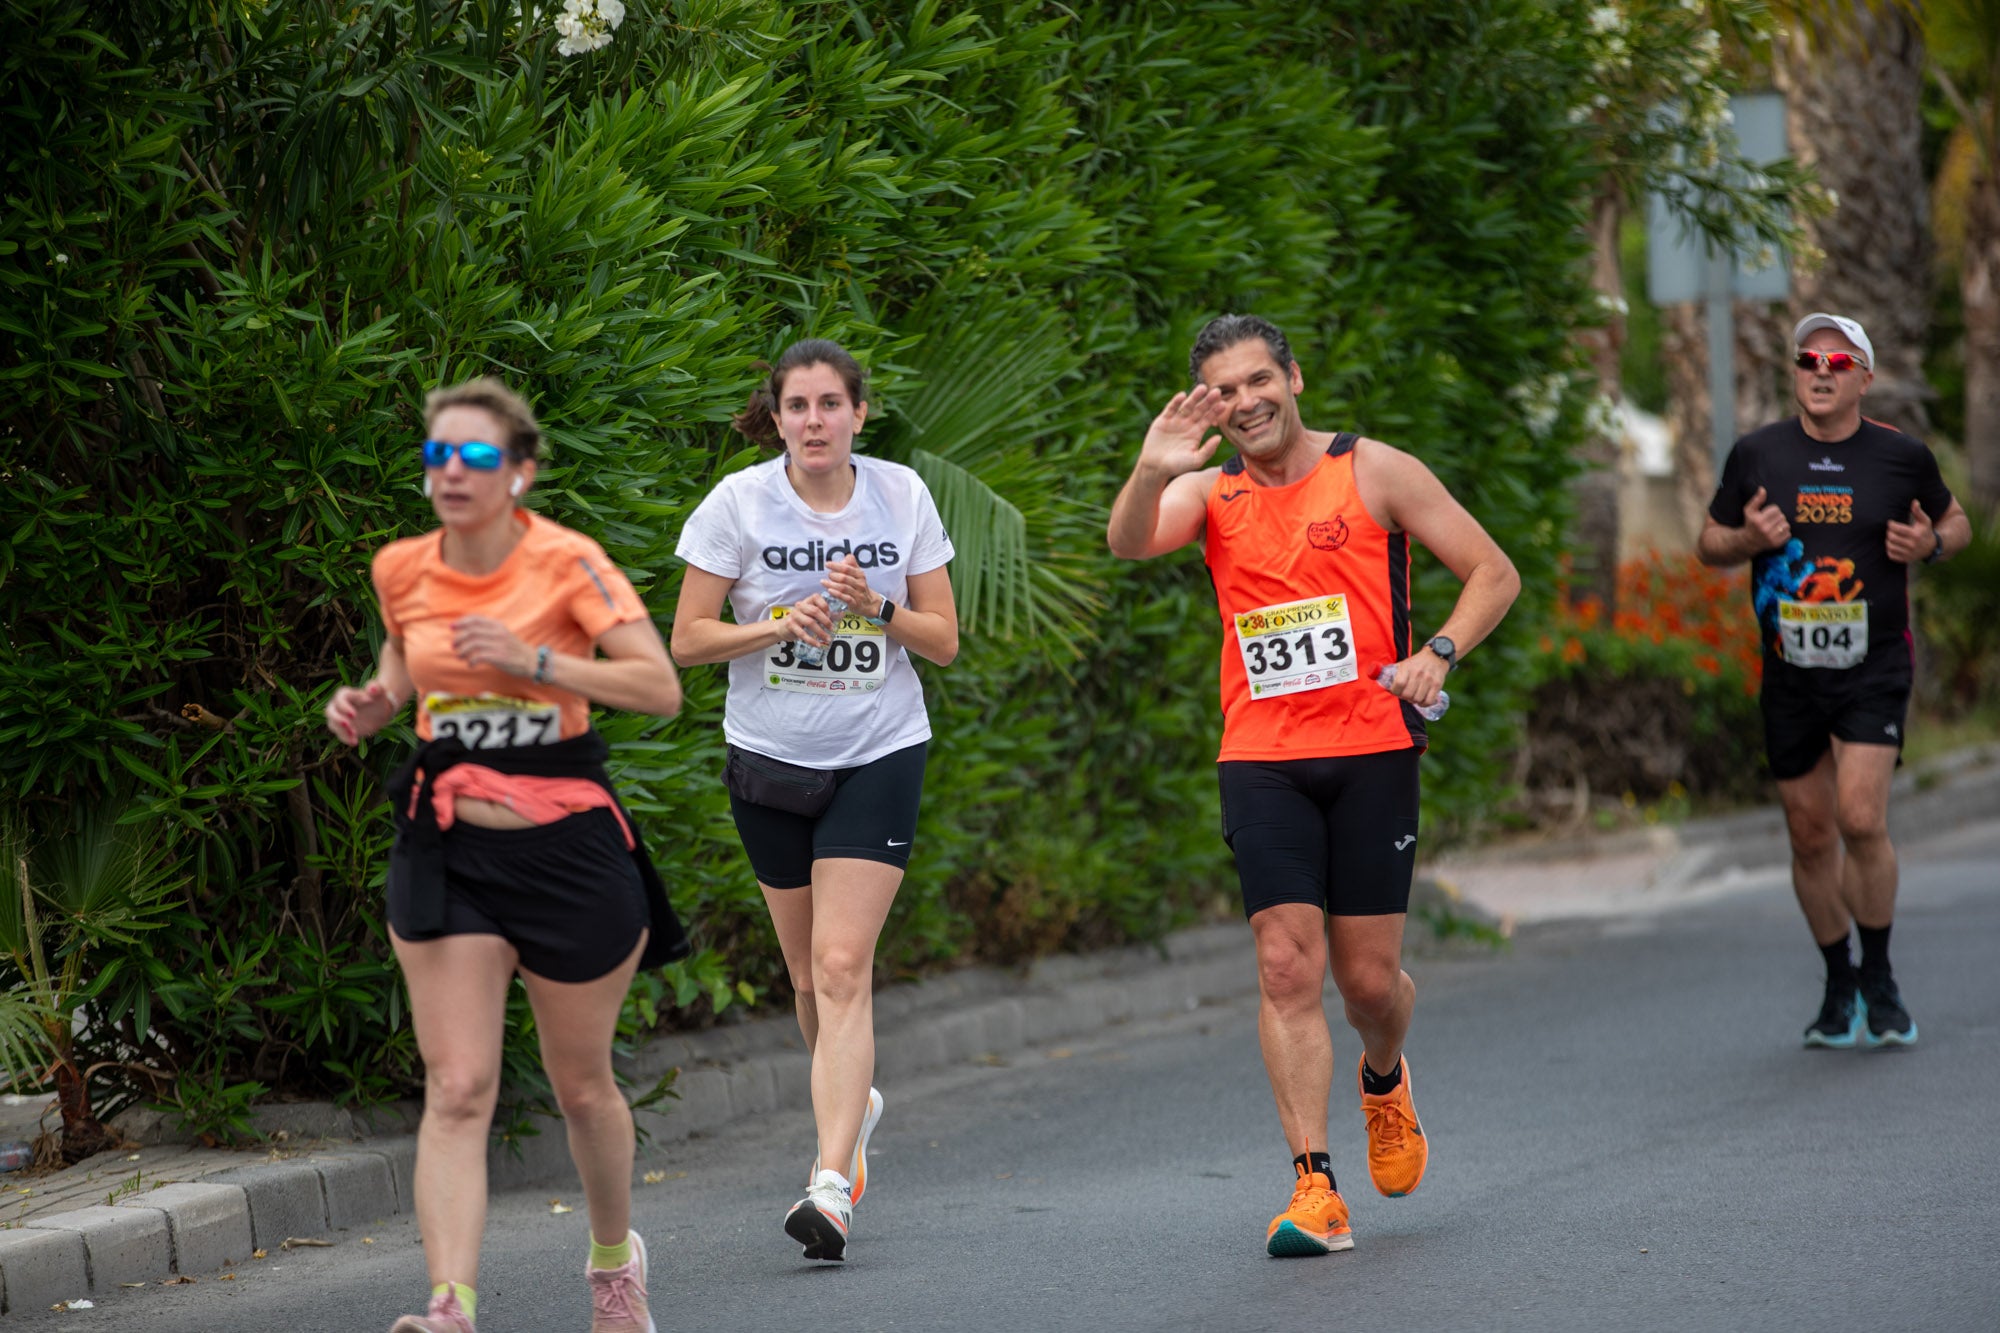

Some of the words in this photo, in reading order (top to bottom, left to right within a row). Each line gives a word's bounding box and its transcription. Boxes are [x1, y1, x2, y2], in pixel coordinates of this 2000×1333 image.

[1797, 493, 1853, 506] FONDO
[1795, 504, 1853, 523] 2025
[763, 539, 899, 571] adidas
[1264, 608, 1323, 629] FONDO
[1266, 608, 1286, 618] GRAN
[1287, 603, 1316, 613] PREMIO
[1792, 626, 1853, 651] 104
[1246, 627, 1349, 675] 3313
